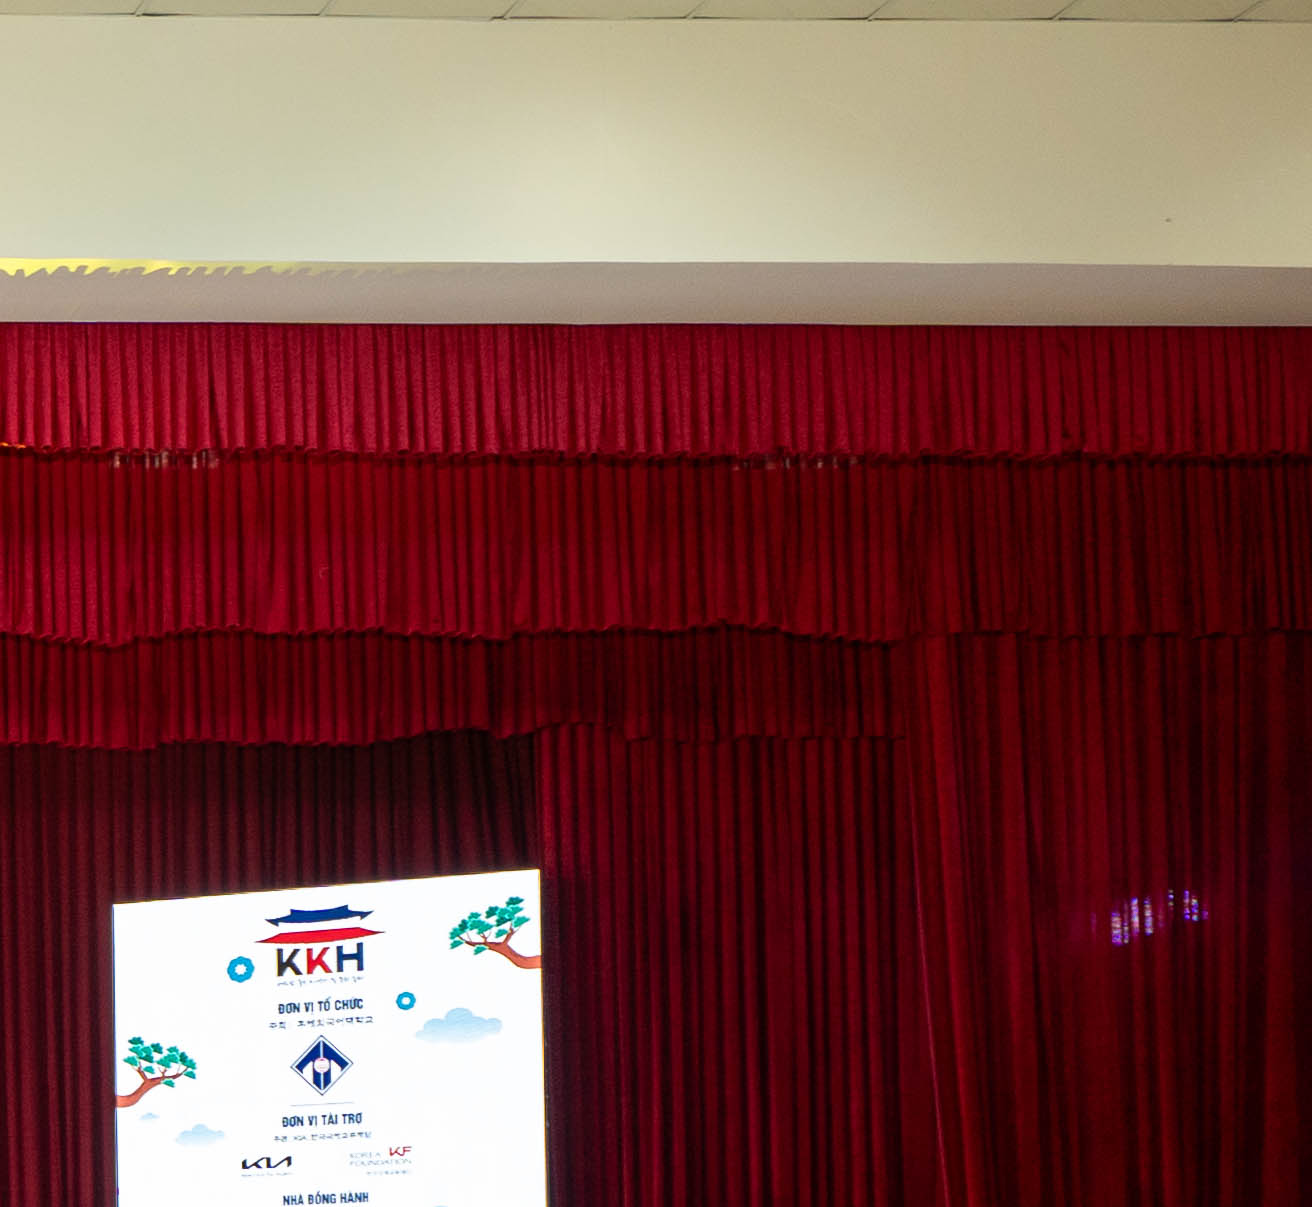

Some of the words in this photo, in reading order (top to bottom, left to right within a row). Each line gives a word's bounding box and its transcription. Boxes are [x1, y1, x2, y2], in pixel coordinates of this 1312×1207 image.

[276, 942, 364, 977] KKH
[278, 1002, 300, 1015] ĐƠN
[304, 1001, 314, 1015] VỊ
[317, 996, 332, 1012] TỐ
[334, 997, 364, 1011] CHỨC
[282, 1115, 304, 1128] ĐƠN
[308, 1115, 318, 1128] VỊ
[321, 1112, 338, 1126] TÀI
[342, 1112, 363, 1125] TRỢ
[388, 1146, 412, 1157] KF
[241, 1156, 292, 1169] KIA
